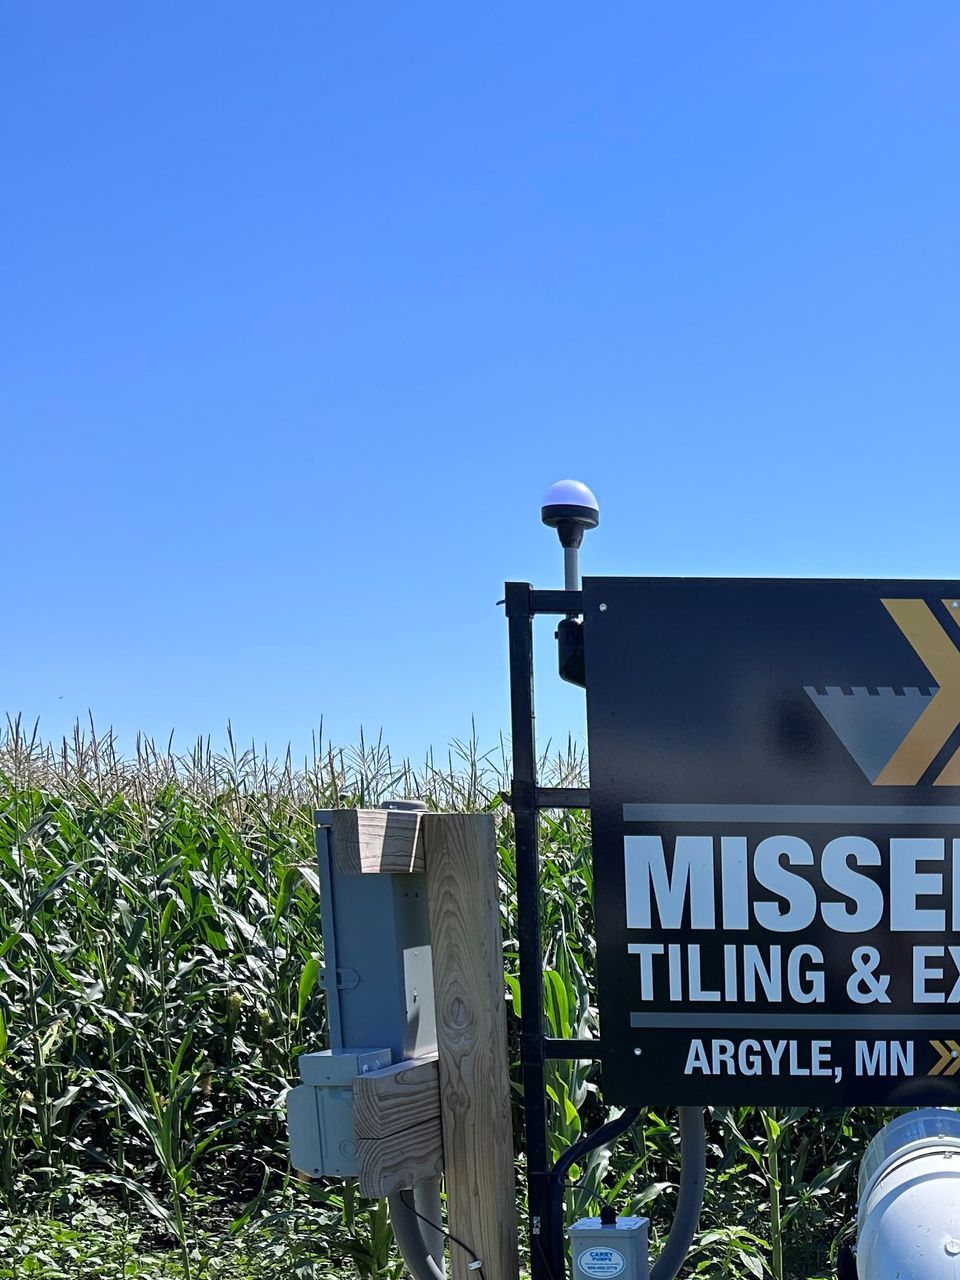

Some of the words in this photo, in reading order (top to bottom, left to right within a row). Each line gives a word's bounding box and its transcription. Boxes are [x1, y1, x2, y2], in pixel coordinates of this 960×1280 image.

[627, 943, 826, 1004] TILING
[845, 945, 892, 1004] &
[684, 1038, 843, 1084] ARGYLE,
[855, 1040, 915, 1077] MN
